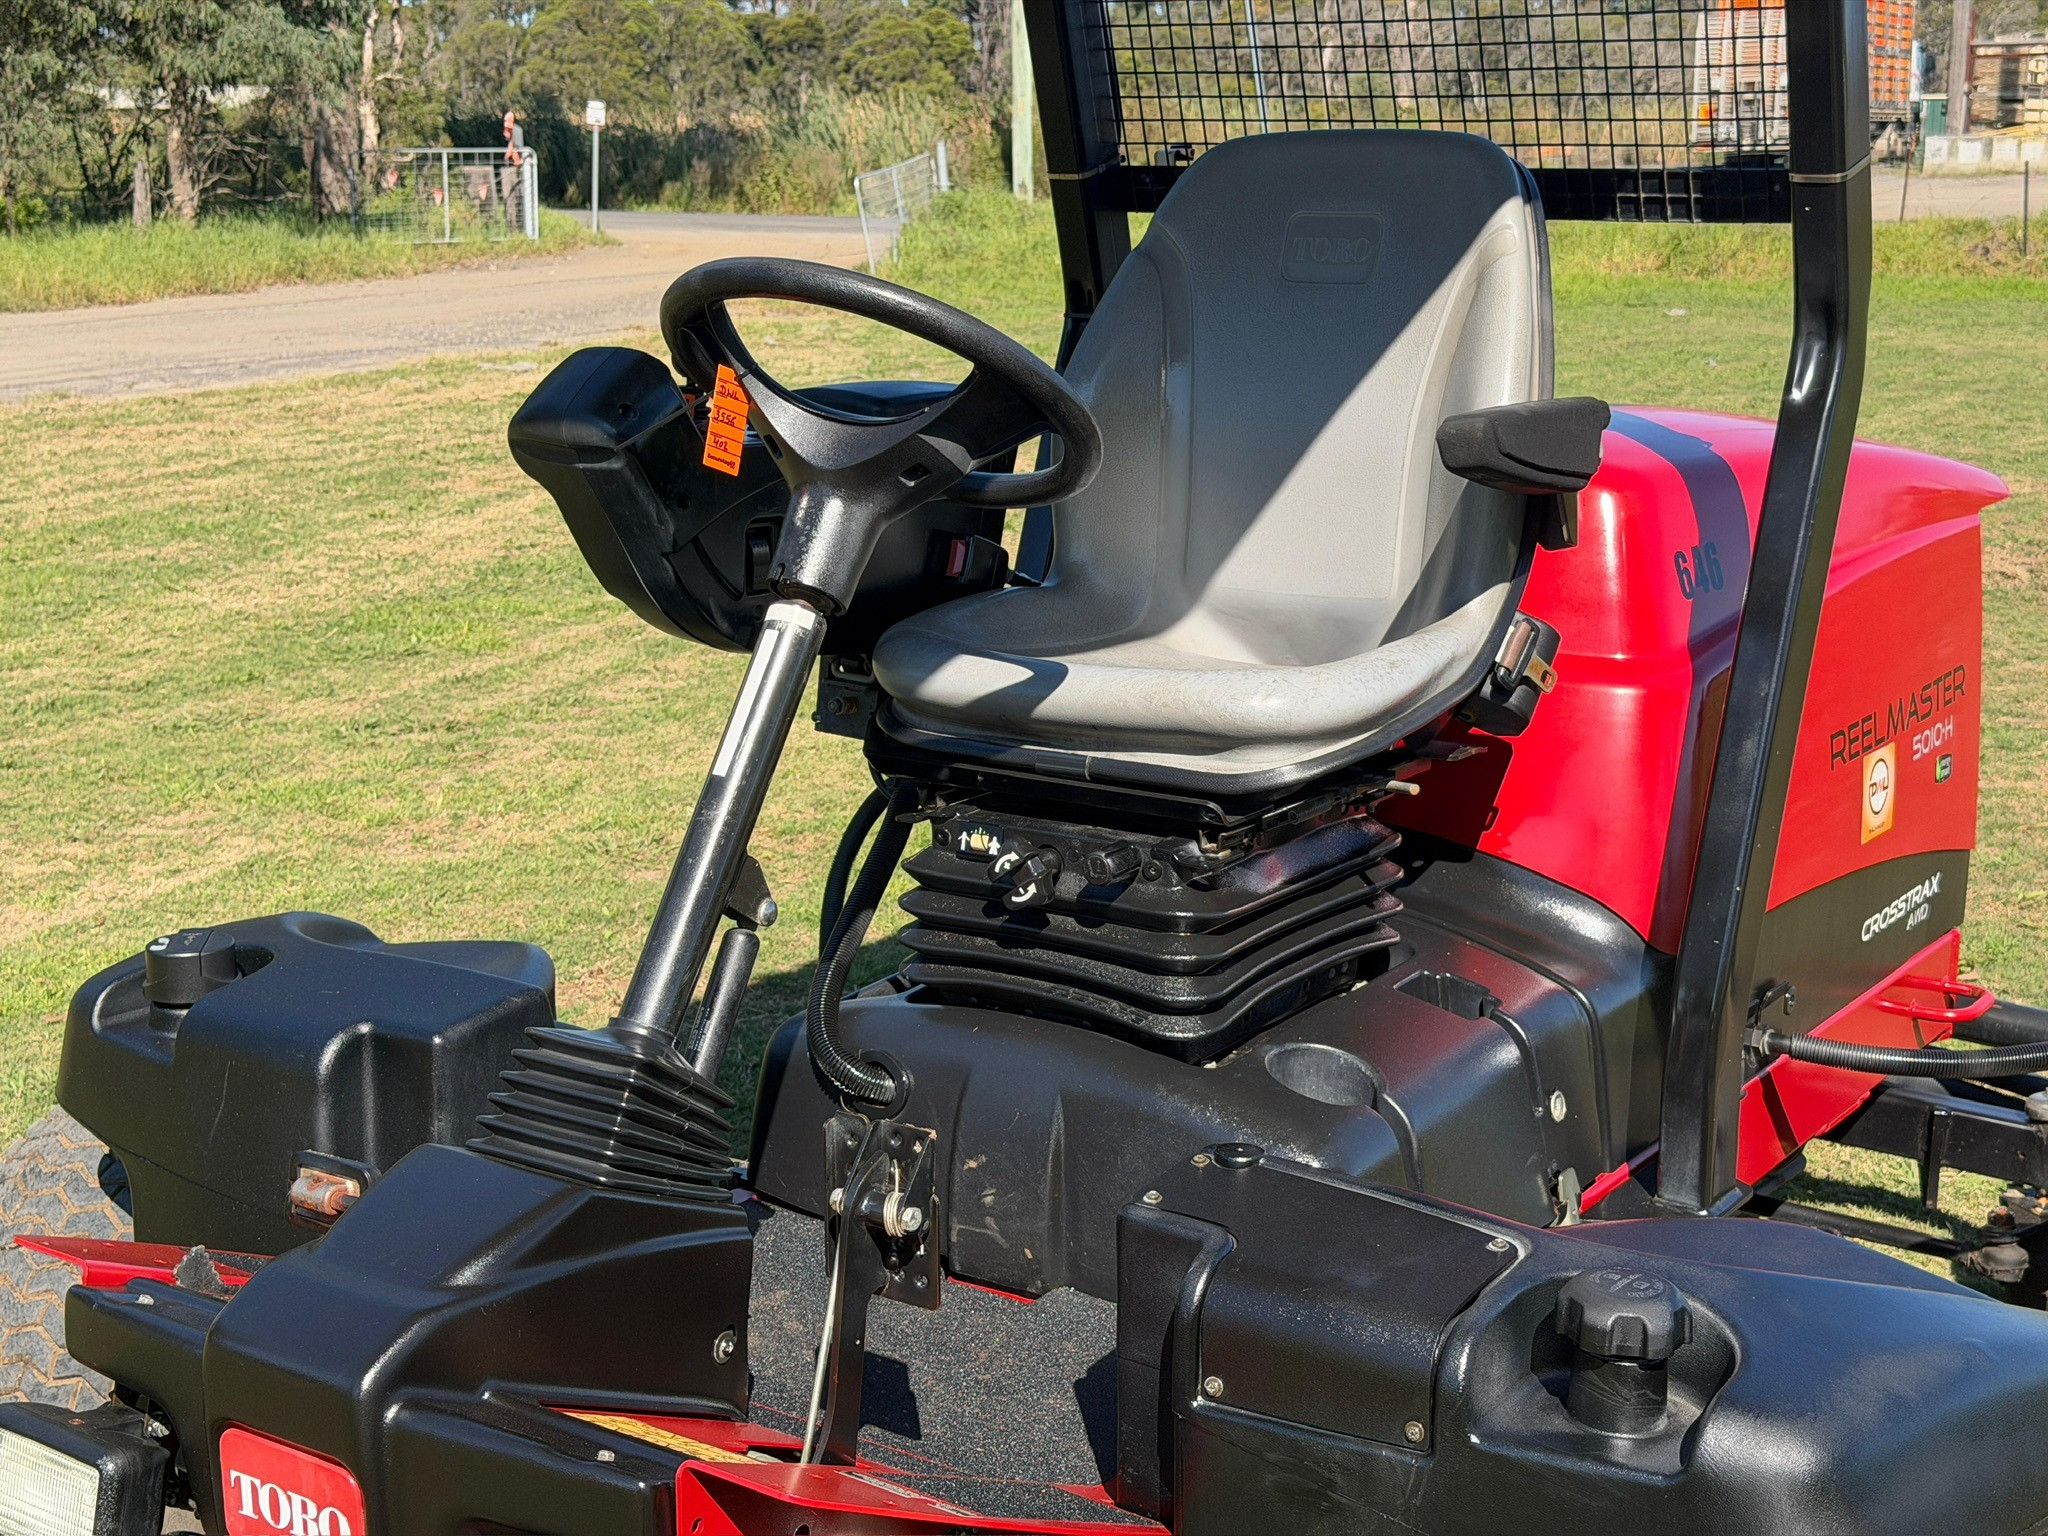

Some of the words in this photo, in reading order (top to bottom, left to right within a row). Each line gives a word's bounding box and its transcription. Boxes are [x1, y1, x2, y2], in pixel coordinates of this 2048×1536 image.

[713, 436, 728, 452] 402
[1674, 541, 1724, 600] 646
[1830, 664, 1966, 771] REELMASTER
[1861, 871, 1942, 942] CROSSTRAX
[1906, 903, 1930, 931] AWD
[230, 1469, 351, 1536] TORO
